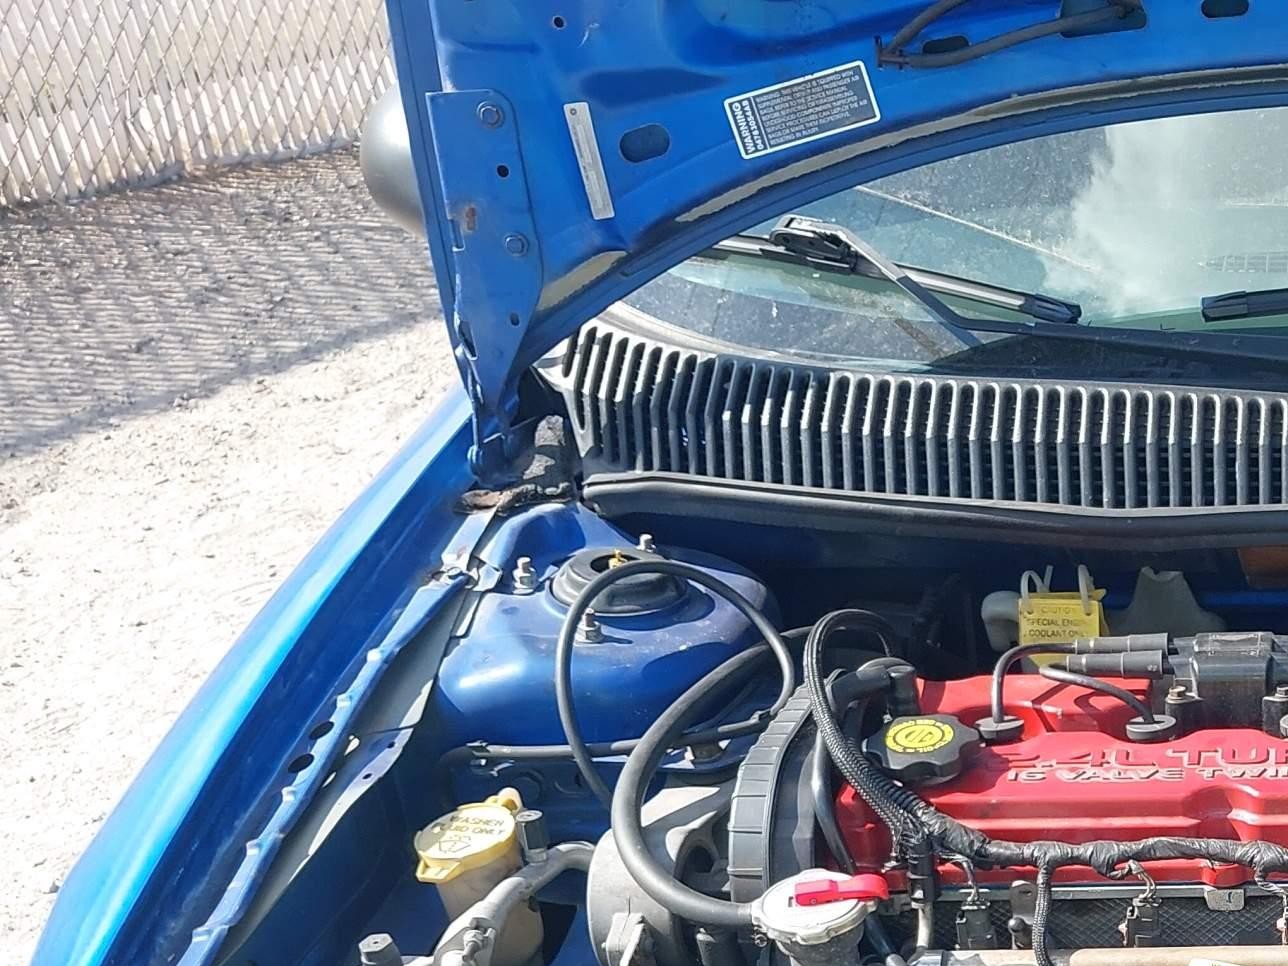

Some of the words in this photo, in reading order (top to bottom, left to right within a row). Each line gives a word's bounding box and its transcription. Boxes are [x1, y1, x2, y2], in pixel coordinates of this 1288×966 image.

[731, 102, 756, 153] WARNING
[1028, 628, 1067, 638] COOLANT
[1000, 747, 1157, 769] 2.4L
[1007, 767, 1047, 781] 16
[1056, 767, 1185, 781] VALVE
